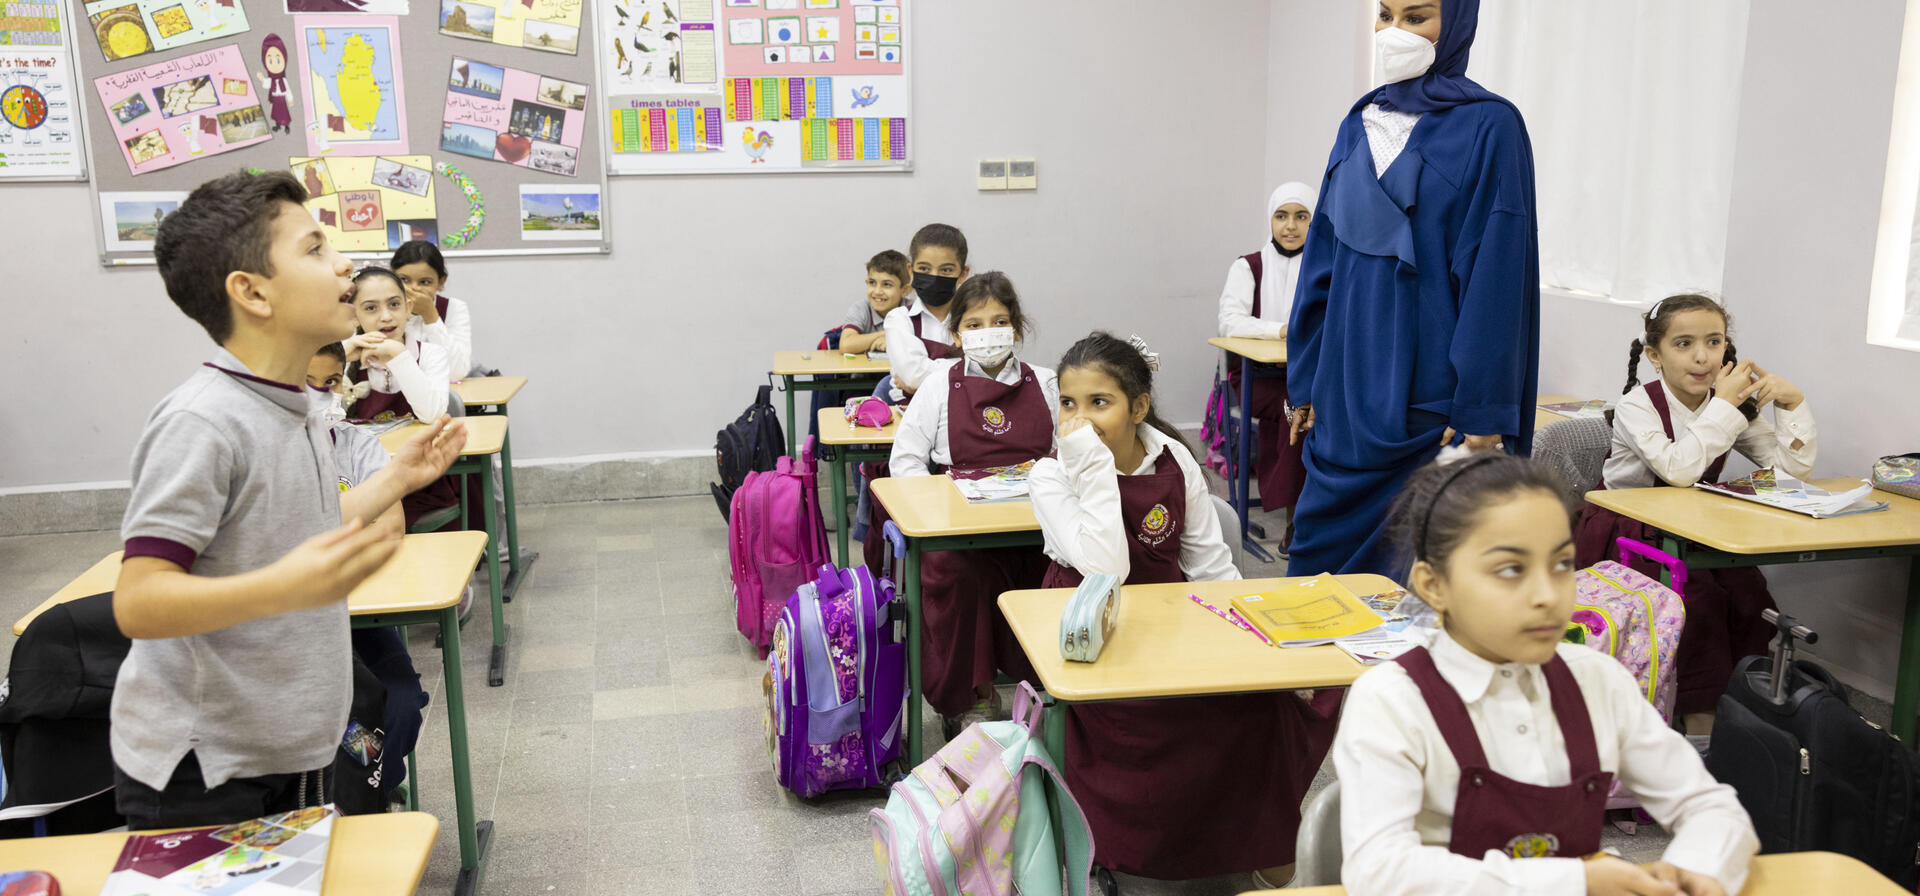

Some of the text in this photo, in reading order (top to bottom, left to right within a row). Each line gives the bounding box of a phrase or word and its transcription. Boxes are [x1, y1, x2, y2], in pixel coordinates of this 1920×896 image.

[14, 57, 29, 68] the
[32, 57, 57, 68] time?
[631, 98, 701, 108] times tables
